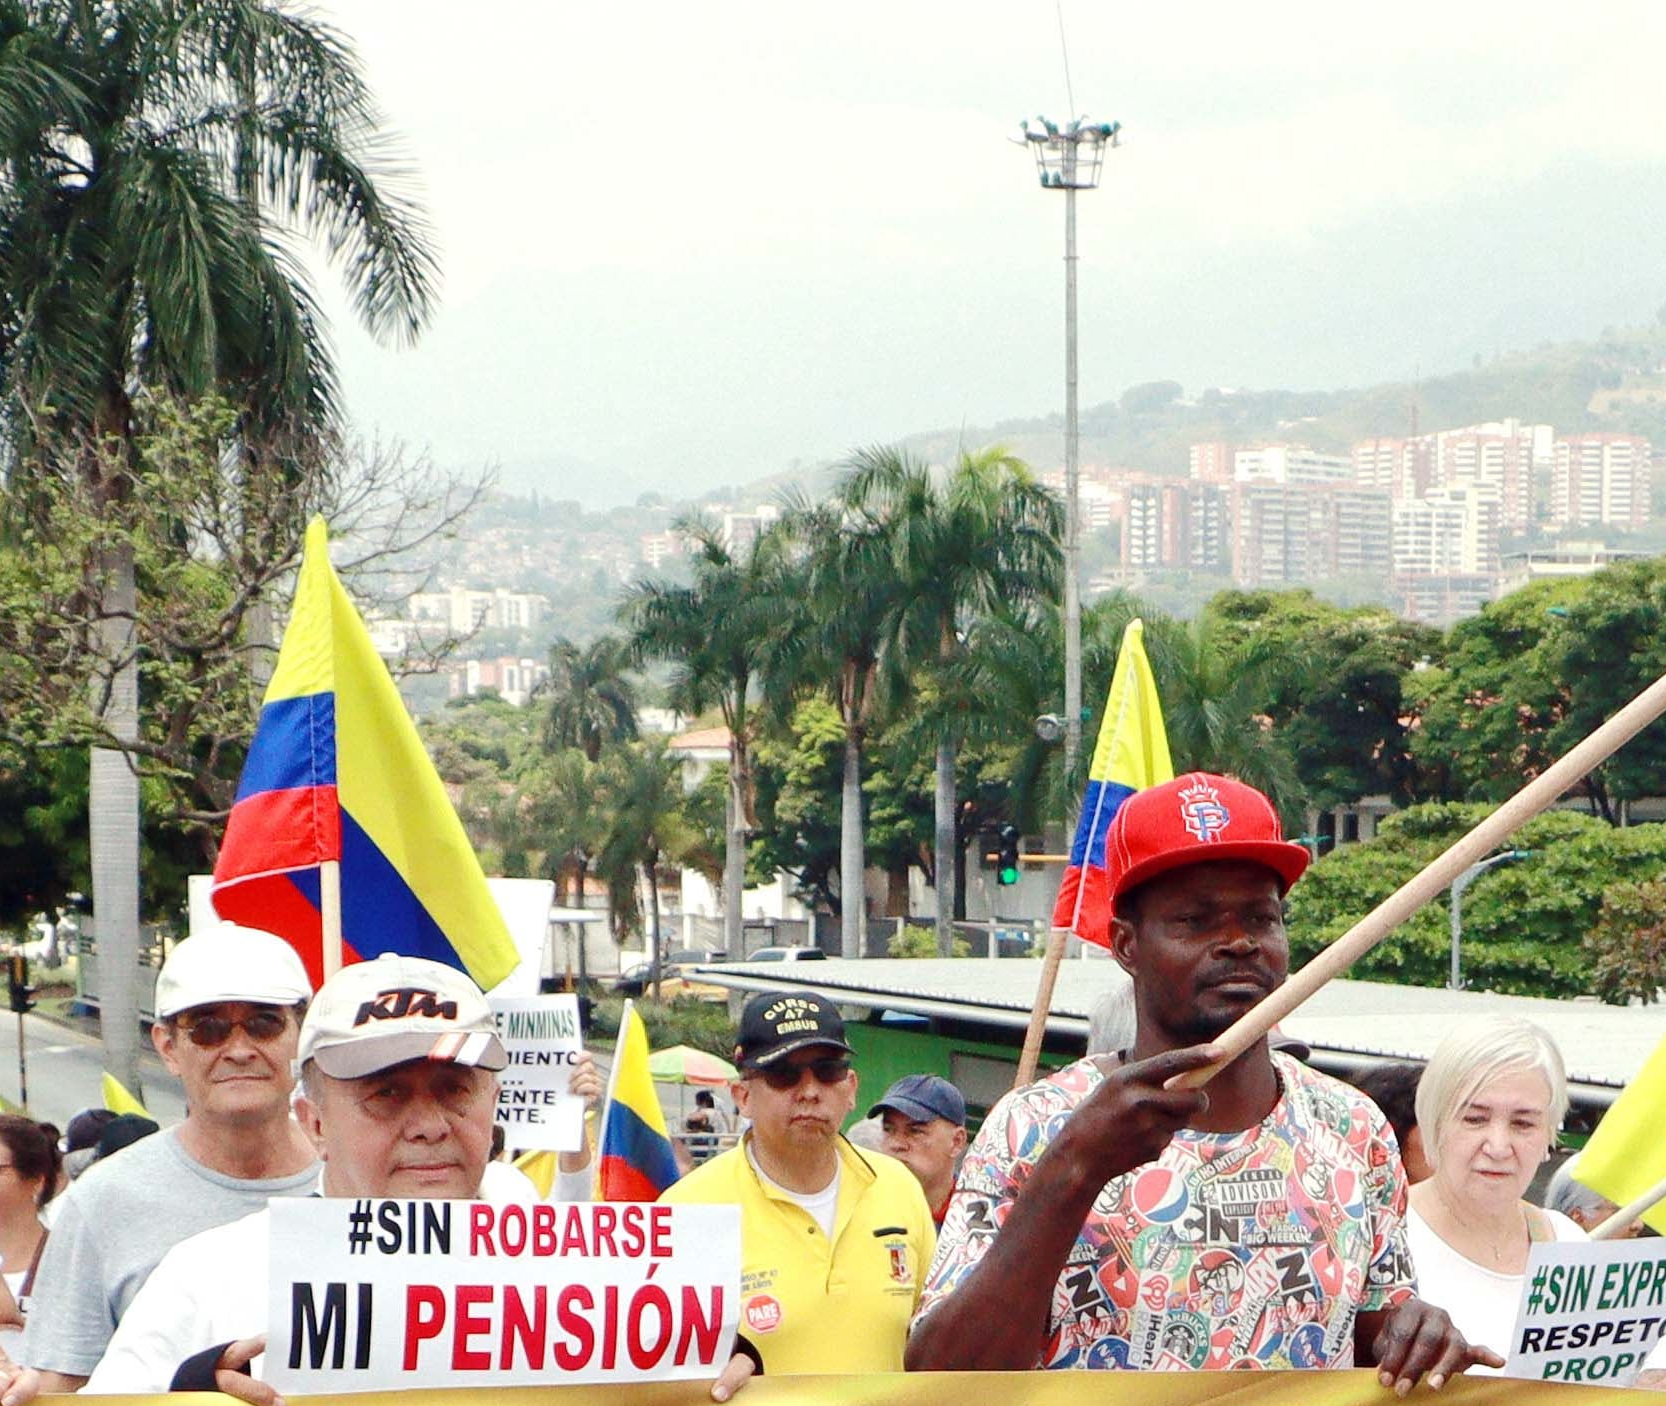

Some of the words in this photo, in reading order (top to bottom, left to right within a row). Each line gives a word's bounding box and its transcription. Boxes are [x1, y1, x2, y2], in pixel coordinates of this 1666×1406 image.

[352, 987, 458, 1029] KTM
[764, 999, 820, 1020] CURSO
[784, 1008, 805, 1019] 47
[507, 1010, 575, 1039] MINMINAS
[1221, 1181, 1283, 1201] ADVISORY
[348, 1199, 452, 1256] #SIN
[470, 1203, 673, 1258] ROBARSE
[1526, 1264, 1596, 1316] #SIN
[288, 1282, 374, 1370] MI
[402, 1263, 724, 1372] PENSIÓN
[748, 1305, 779, 1323] PARE
